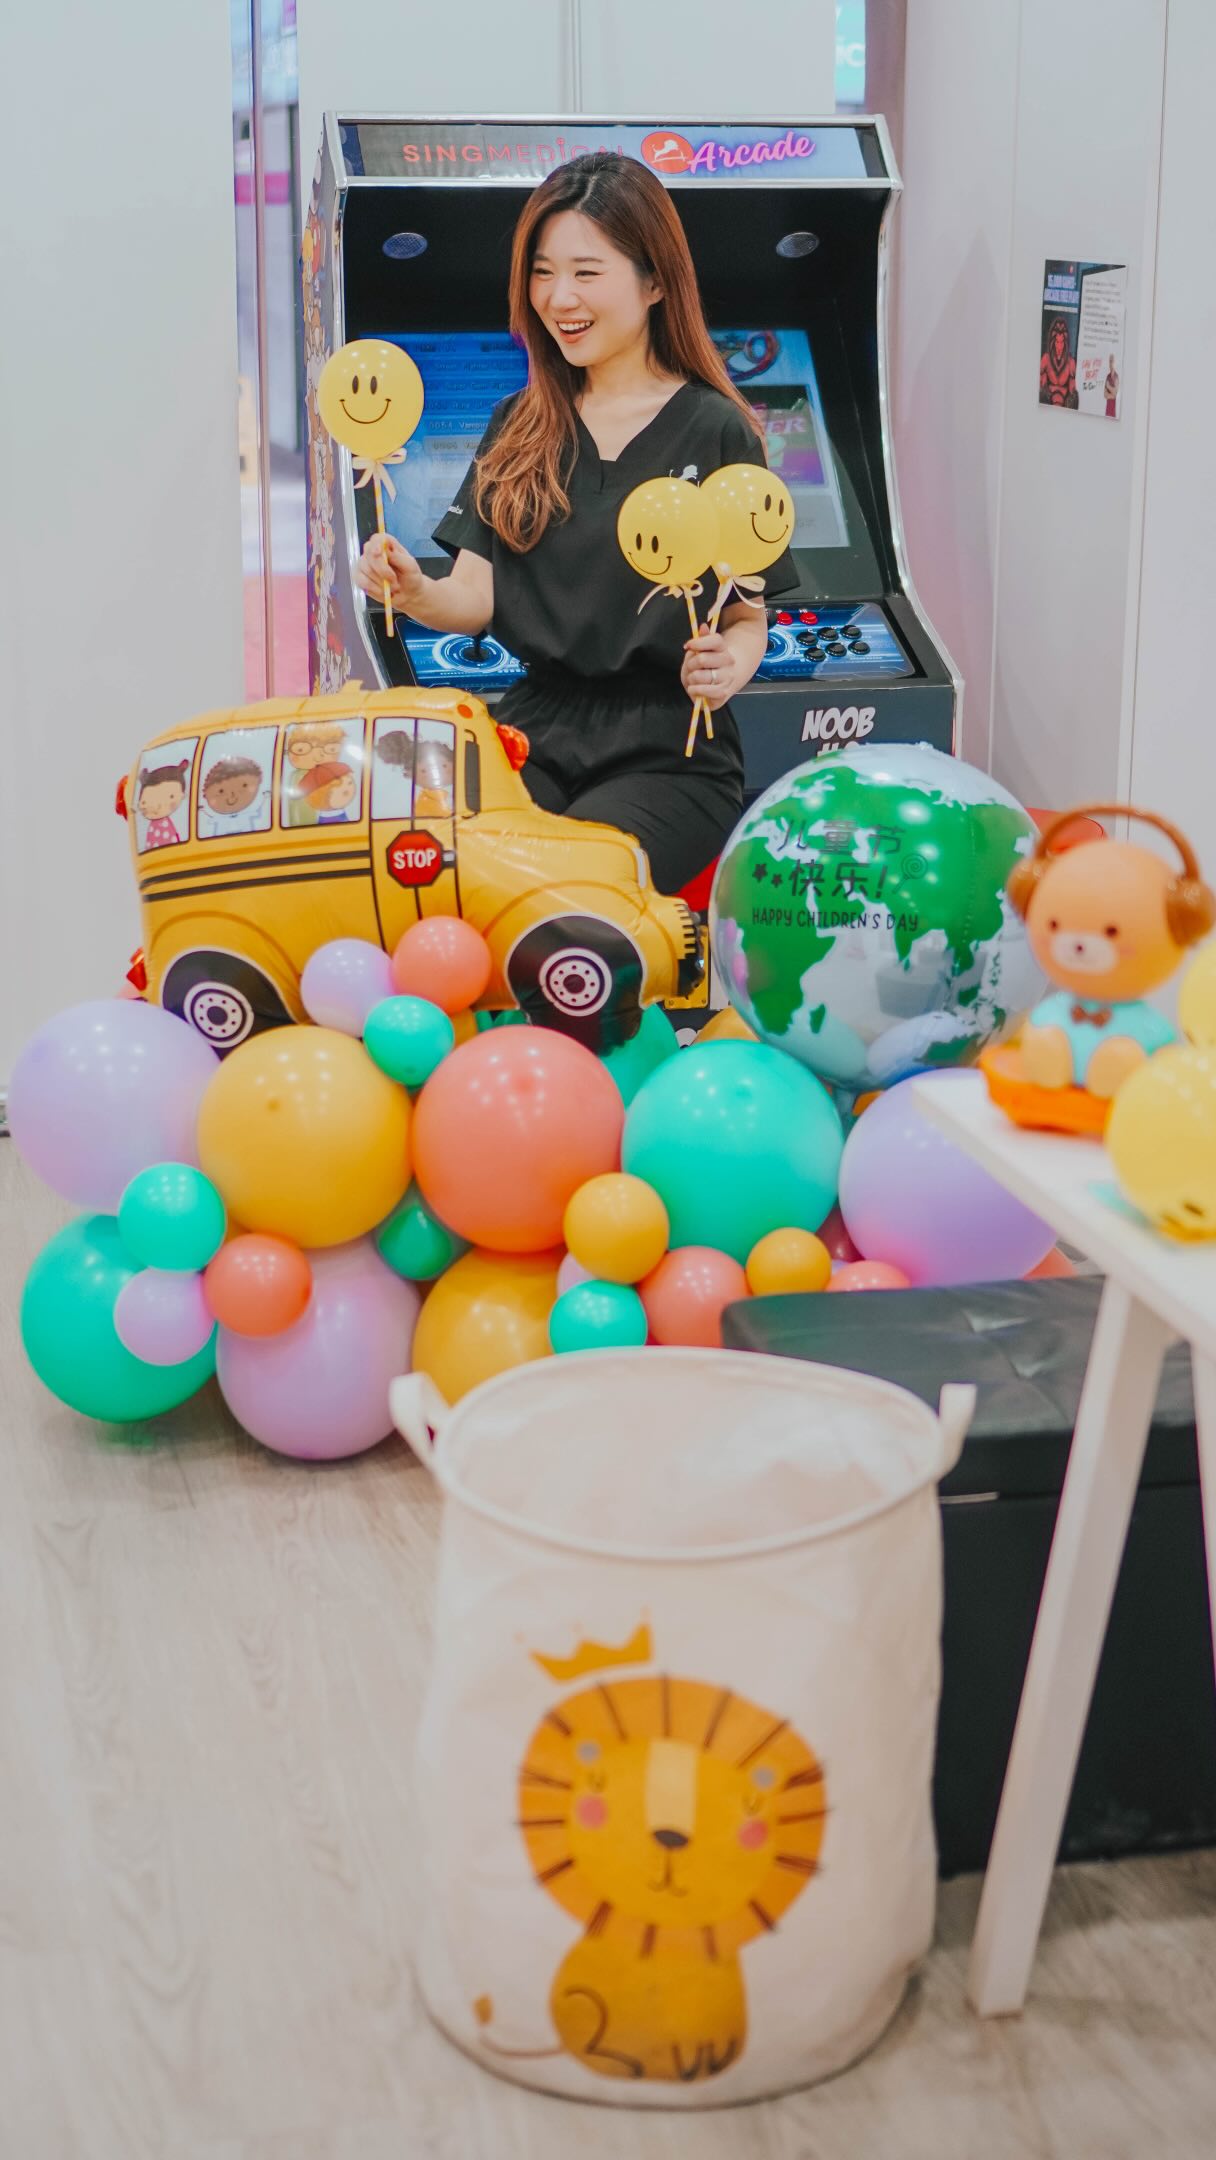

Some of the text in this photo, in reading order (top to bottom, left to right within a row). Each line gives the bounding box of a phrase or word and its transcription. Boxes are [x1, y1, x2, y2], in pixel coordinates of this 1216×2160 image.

[687, 131, 816, 174] Arcade
[801, 706, 876, 742] NOOB
[777, 819, 905, 857] 儿童节
[393, 848, 436, 870] STOP
[752, 908, 919, 931] HAPPY CHILDREN'S DAY
